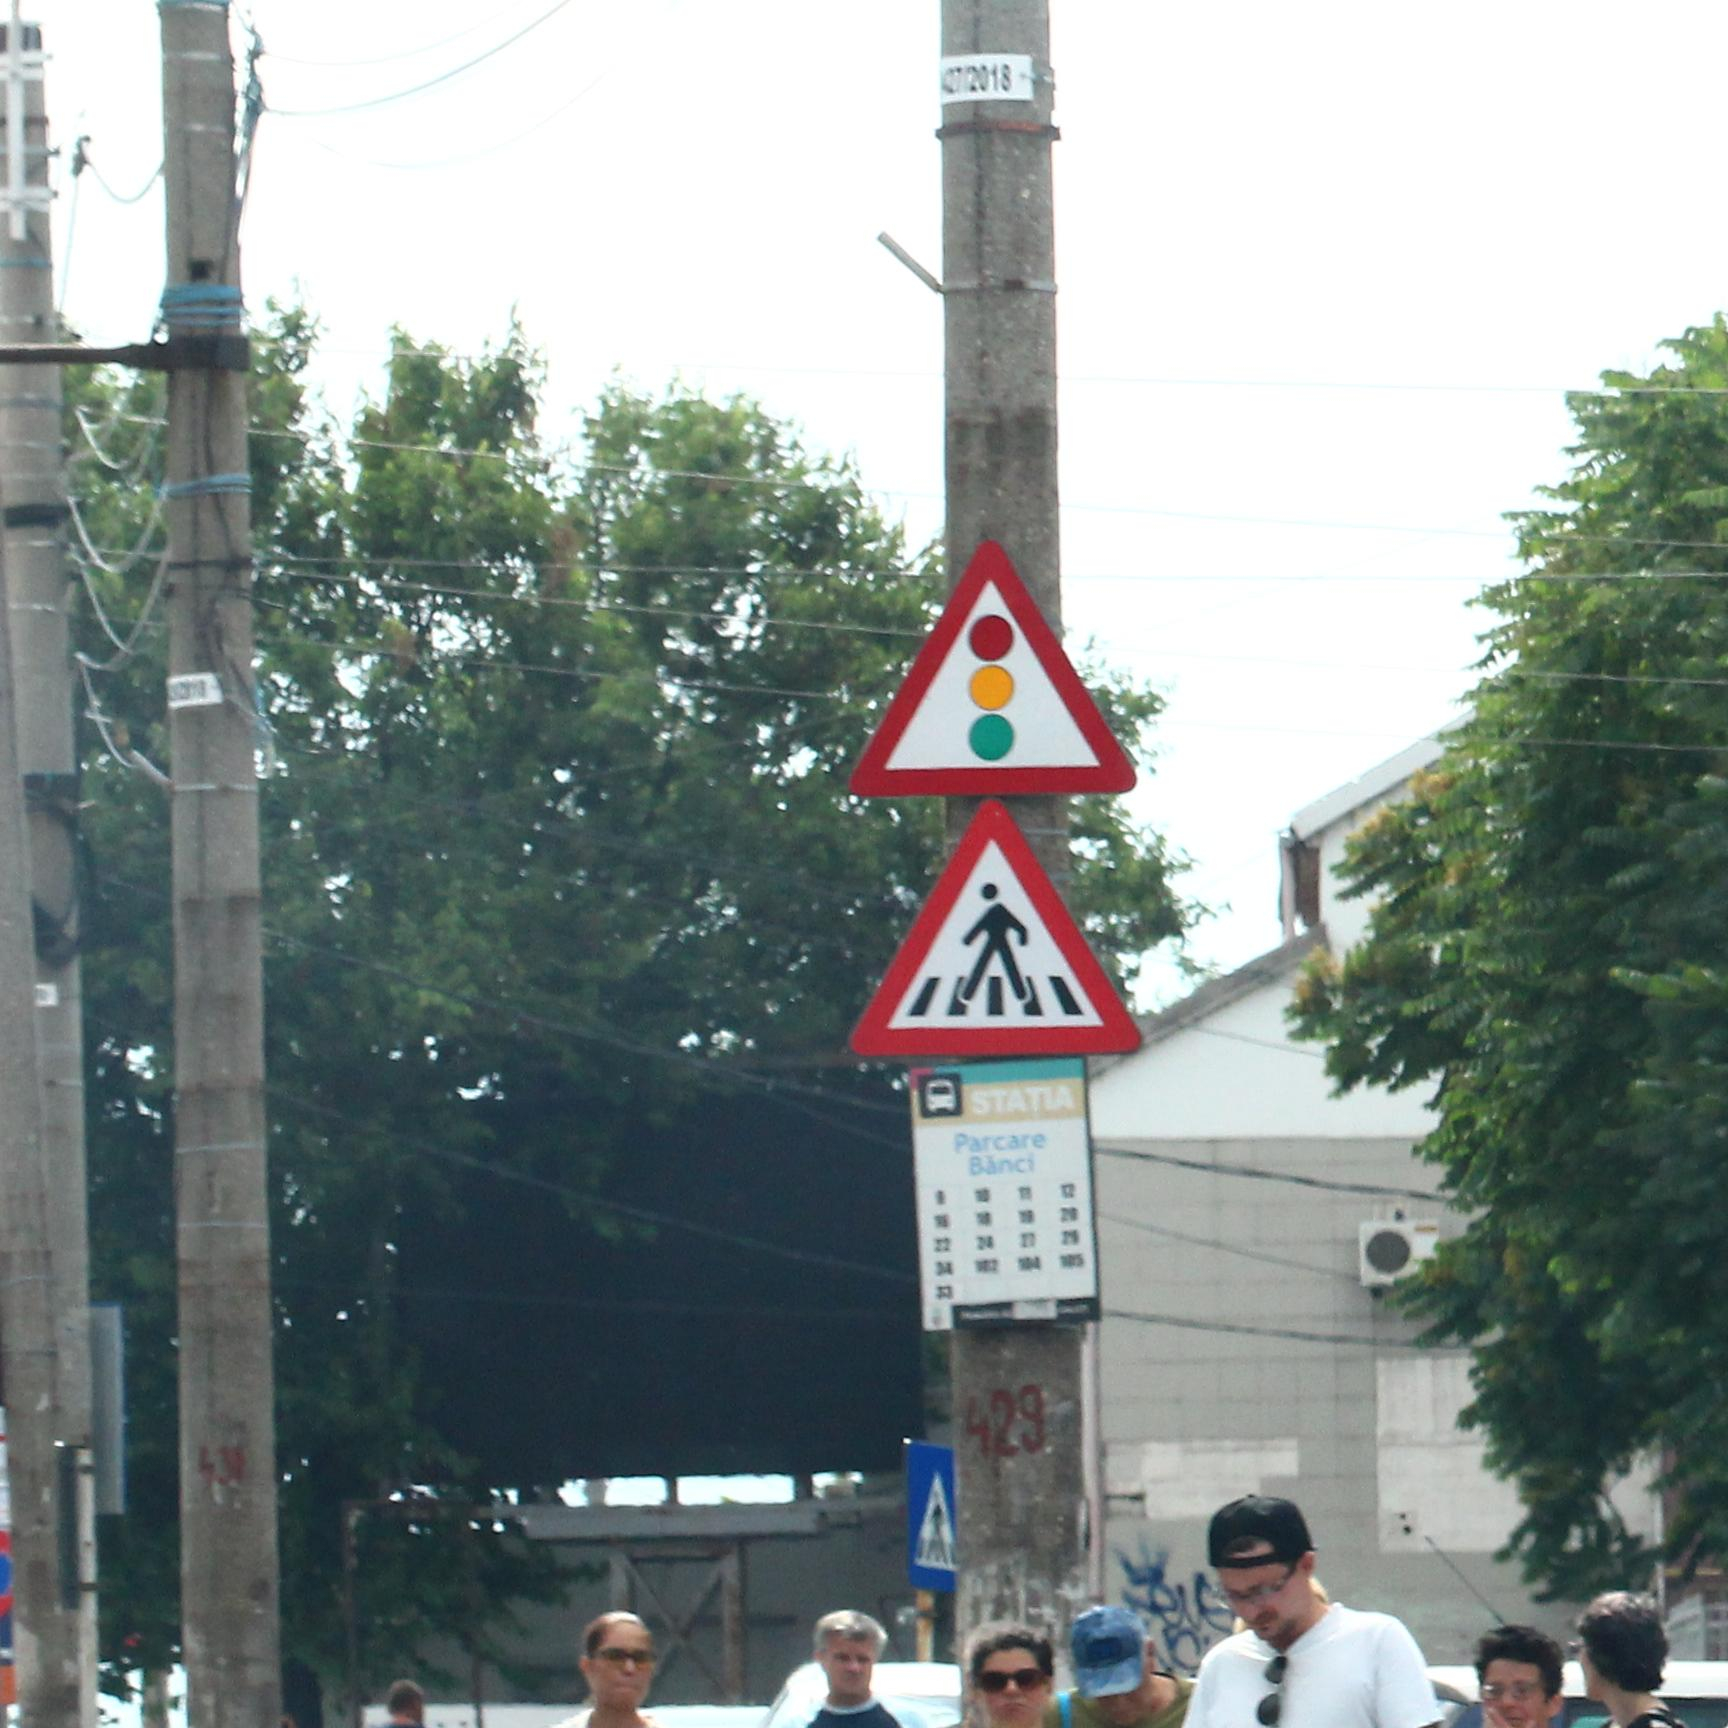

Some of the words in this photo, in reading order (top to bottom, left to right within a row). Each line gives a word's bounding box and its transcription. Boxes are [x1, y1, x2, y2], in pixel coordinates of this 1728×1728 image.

[955, 1132, 1046, 1152] Parcare
[1061, 1184, 1076, 1199] 12
[966, 1384, 1044, 1457] 429
